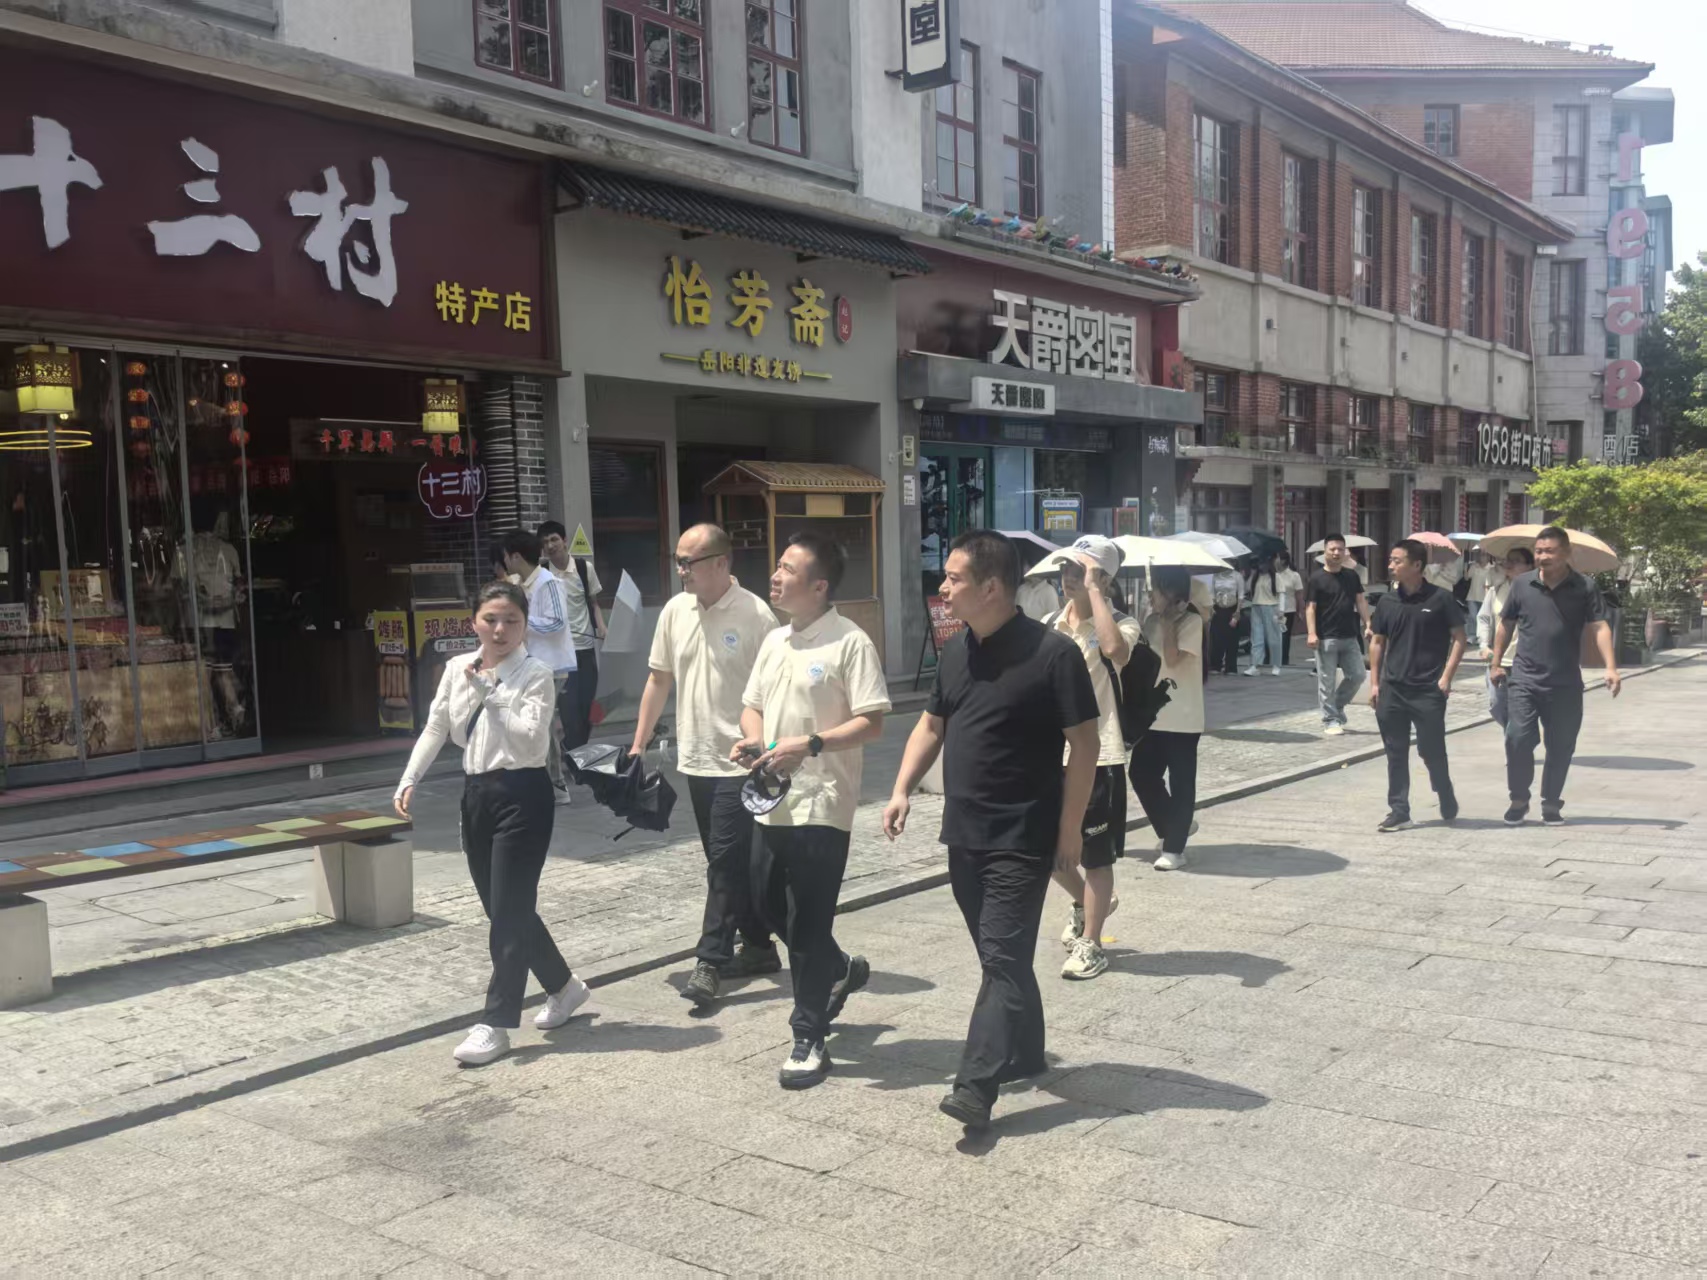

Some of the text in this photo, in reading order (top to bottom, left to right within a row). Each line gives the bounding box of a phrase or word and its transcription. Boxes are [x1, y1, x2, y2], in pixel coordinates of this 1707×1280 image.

[0, 115, 409, 307] 十三村
[435, 281, 531, 332] 特产店
[665, 256, 831, 347] 怡芳斋
[989, 289, 1137, 383] 天爵密室
[422, 467, 481, 498] 十三村
